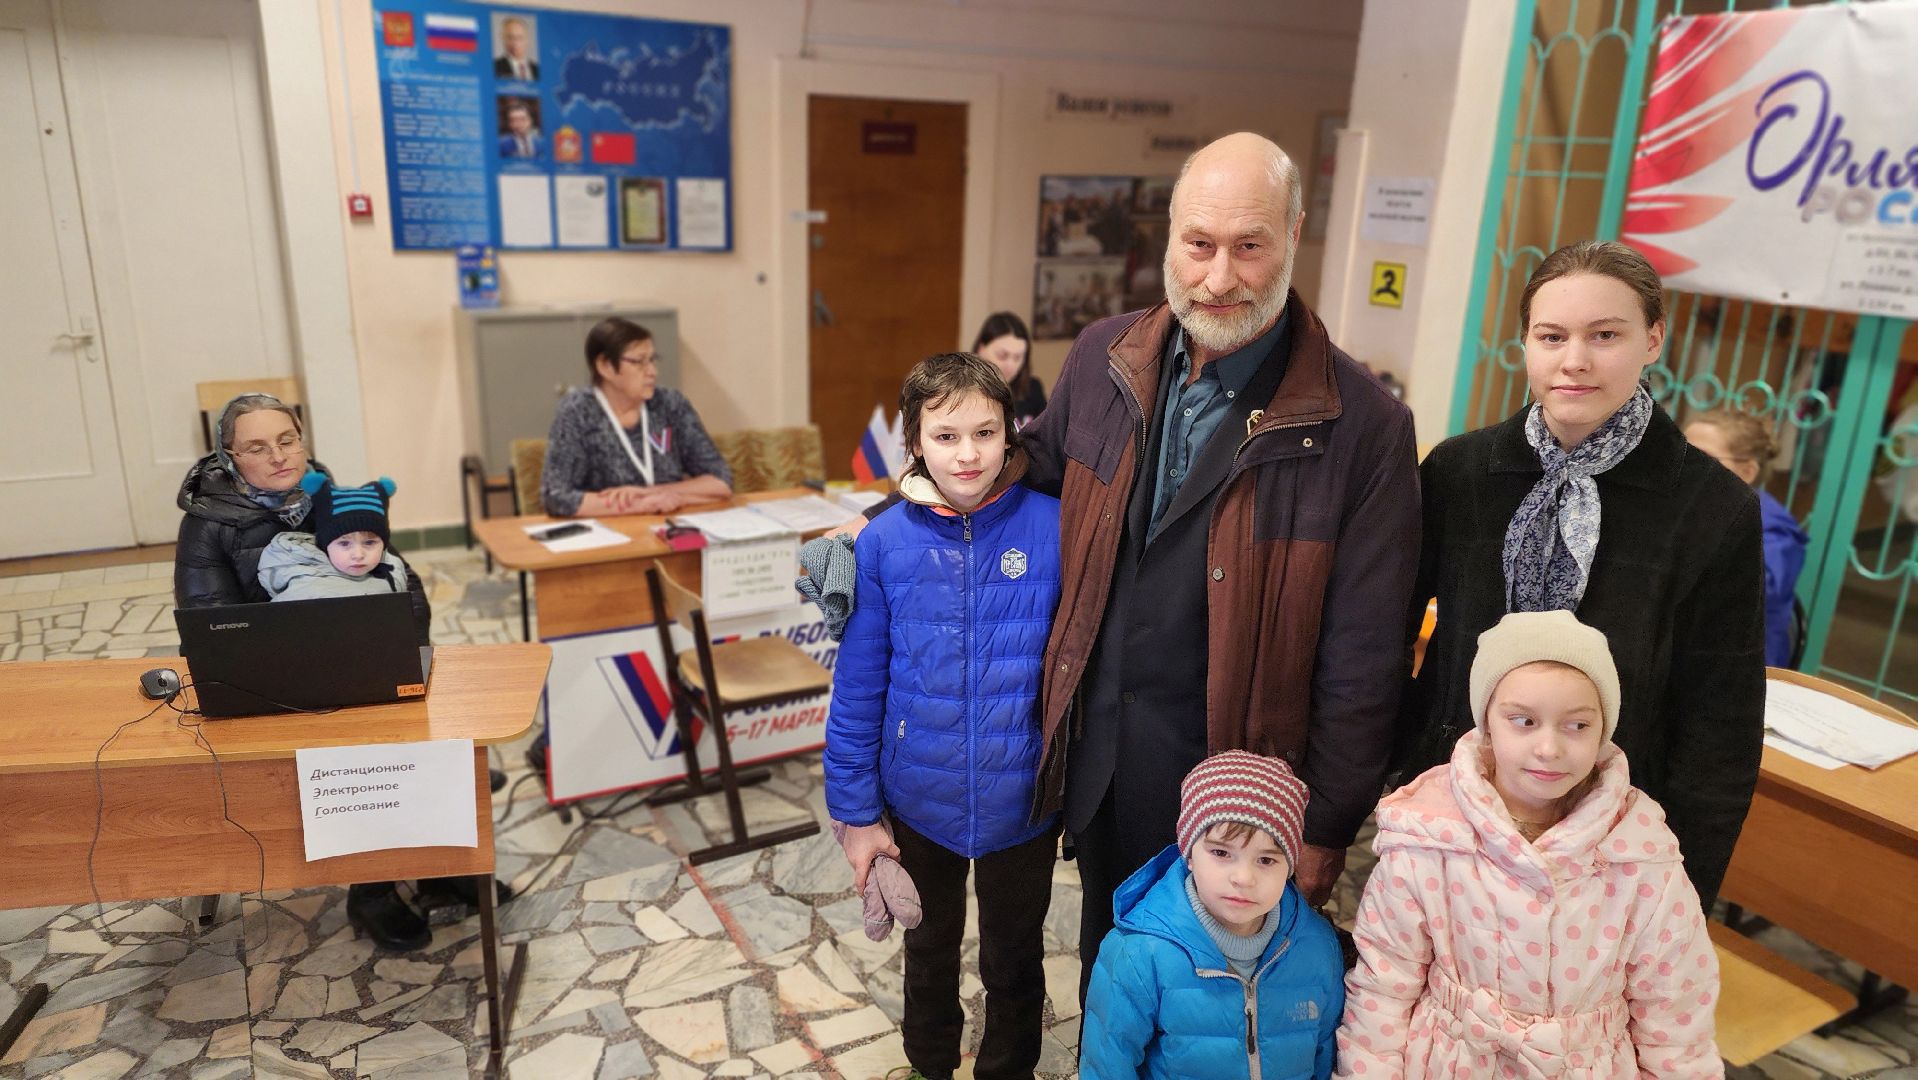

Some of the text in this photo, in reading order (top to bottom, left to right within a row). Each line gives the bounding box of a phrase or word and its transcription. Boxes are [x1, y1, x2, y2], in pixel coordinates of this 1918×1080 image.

[210, 622, 249, 630] Lenovo
[767, 706, 827, 737] МАРТА
[310, 763, 416, 781] Дистанционное
[313, 783, 400, 800] Электронное
[314, 800, 401, 819] Голосование
